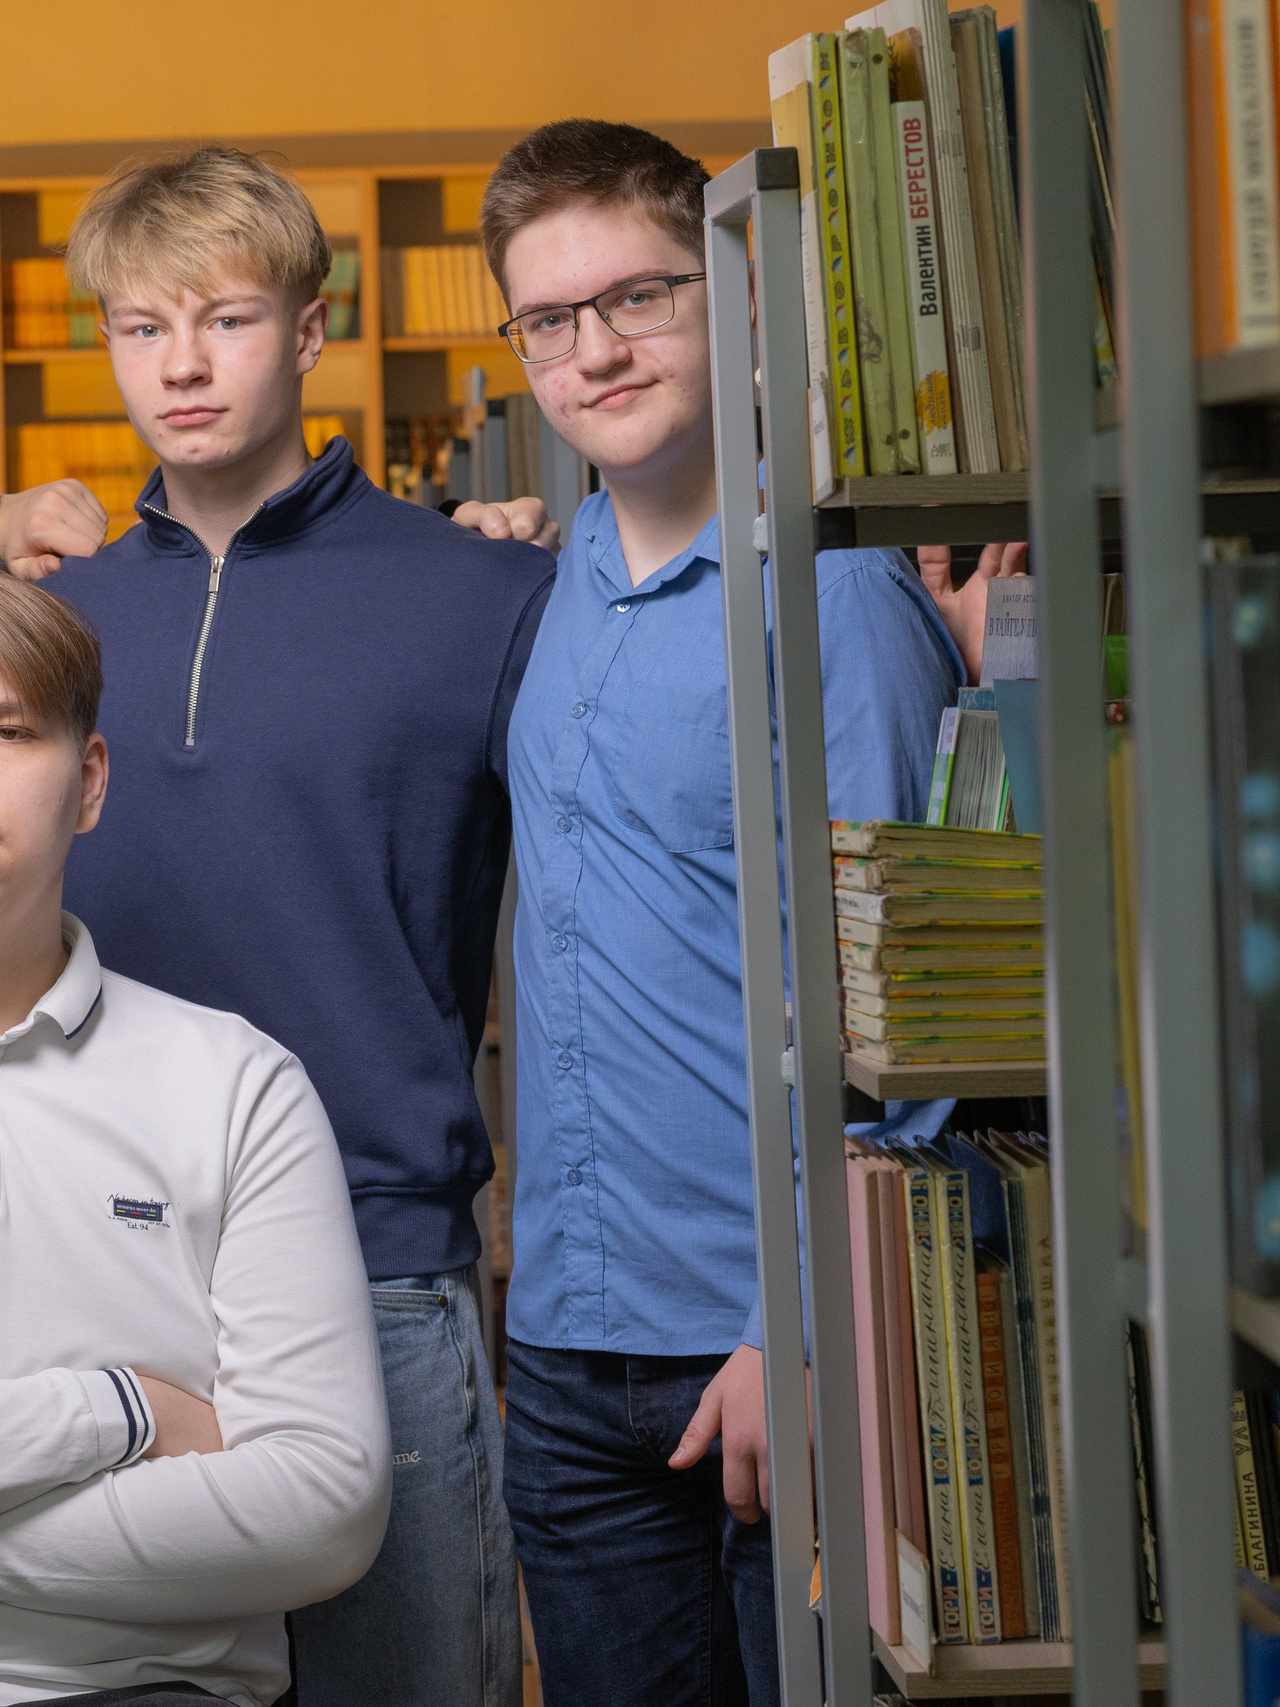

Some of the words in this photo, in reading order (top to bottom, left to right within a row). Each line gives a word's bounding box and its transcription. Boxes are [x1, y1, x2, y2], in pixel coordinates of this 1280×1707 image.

[904, 117, 928, 219] БЕРЕСТОВ
[919, 225, 938, 316] Валентин
[140, 1223, 149, 1231] 94
[1242, 1472, 1265, 1571] БЛАГИНИНА
